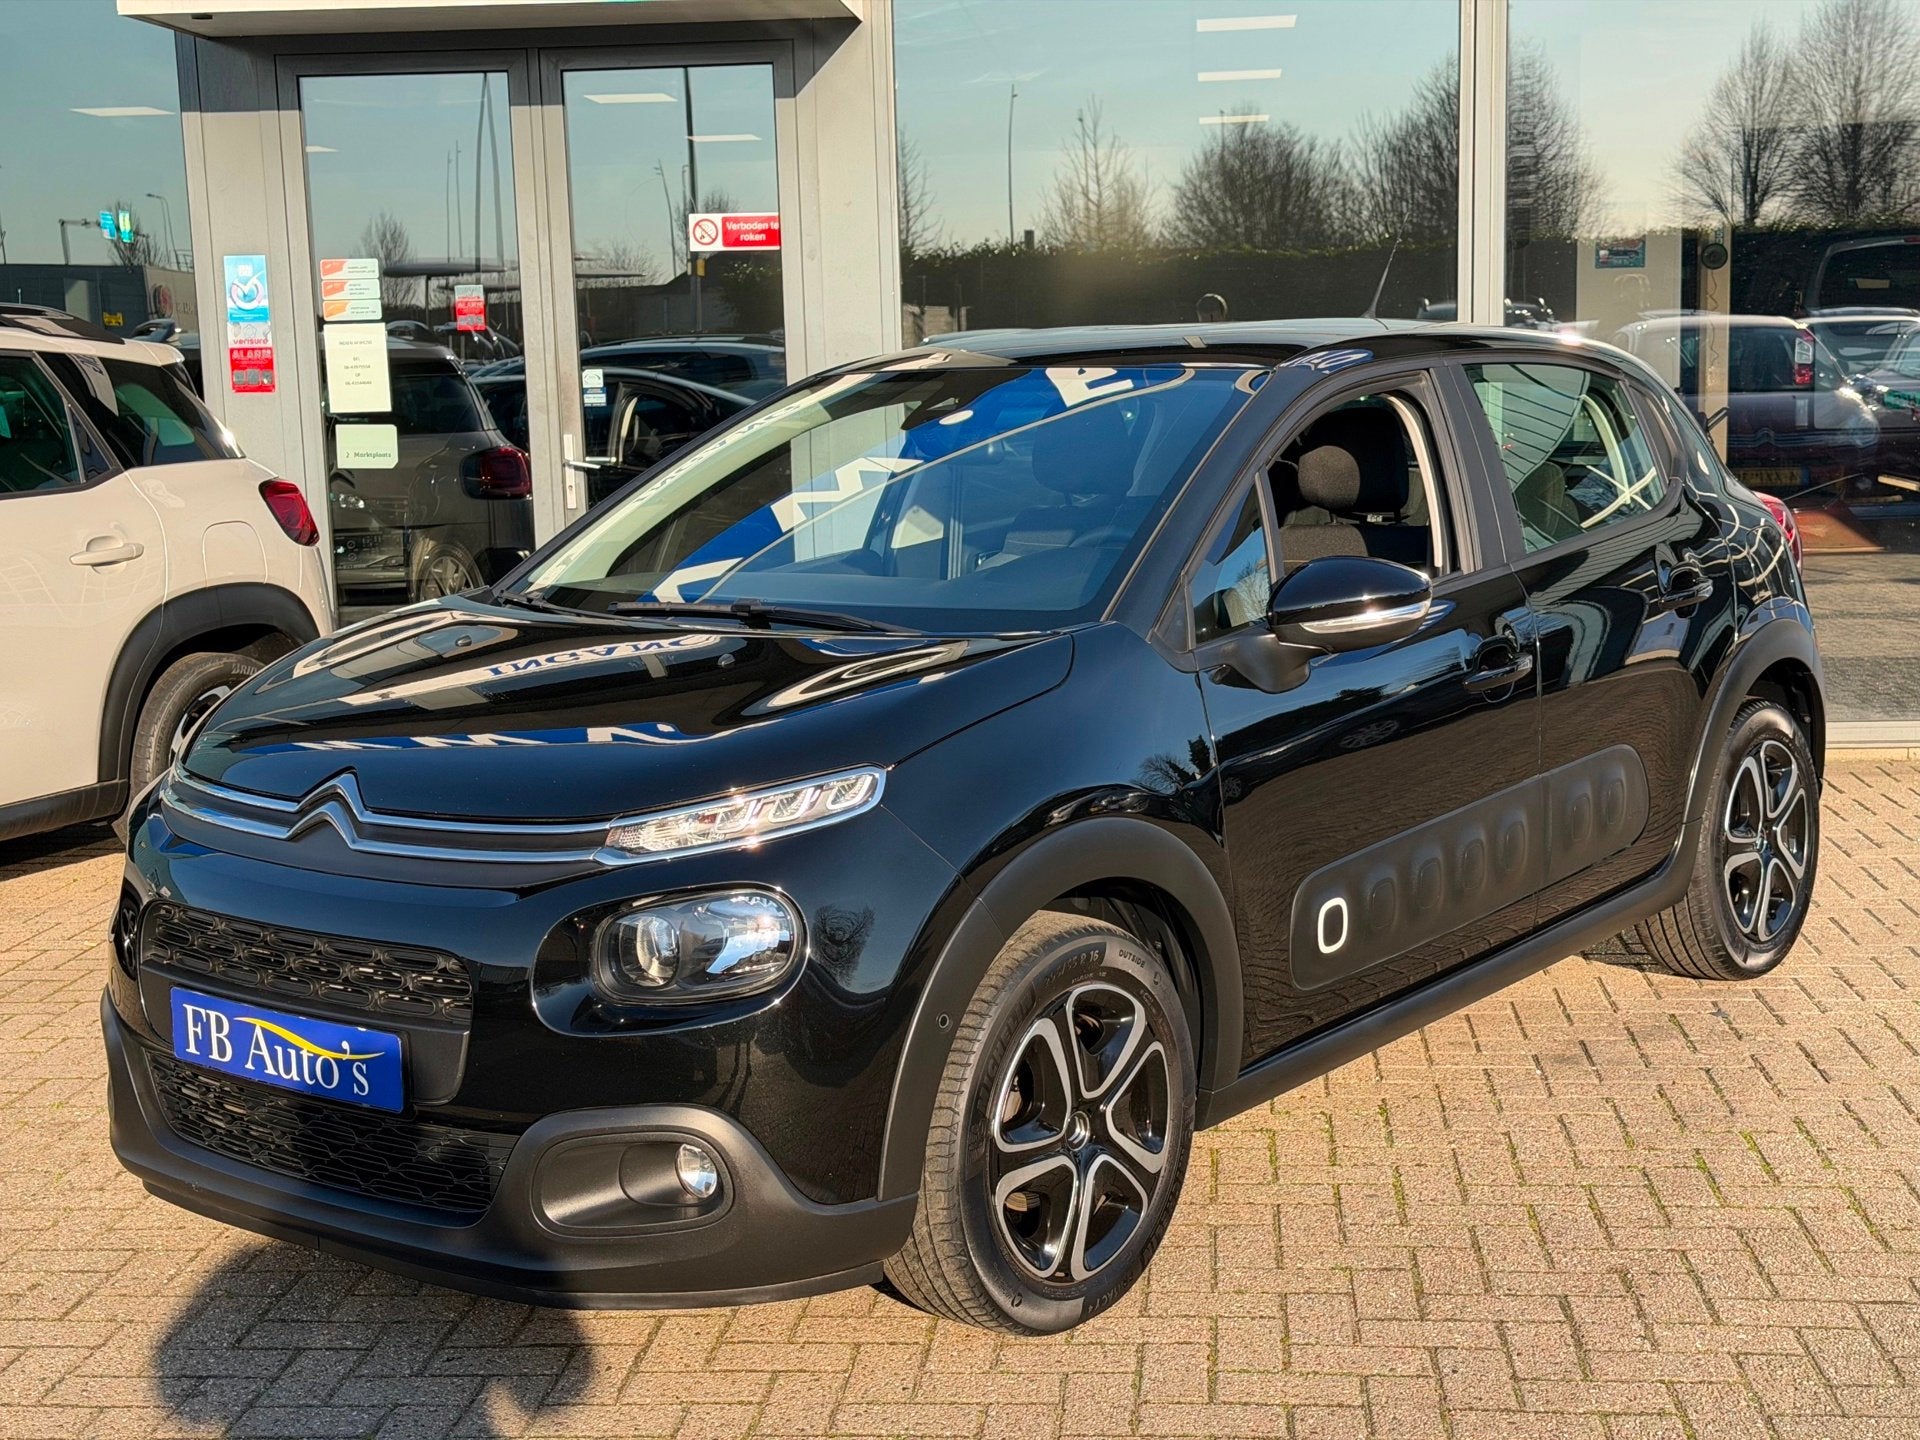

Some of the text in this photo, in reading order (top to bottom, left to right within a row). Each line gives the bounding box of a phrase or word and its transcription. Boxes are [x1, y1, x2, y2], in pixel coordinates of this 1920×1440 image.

[726, 221, 780, 231] Verboden te
[740, 233, 766, 241] roken
[232, 349, 272, 361] ALARM
[354, 451, 392, 459] Marktplaats
[1118, 949, 1146, 968] OUTSIDE
[182, 1003, 370, 1096] FB Auto's
